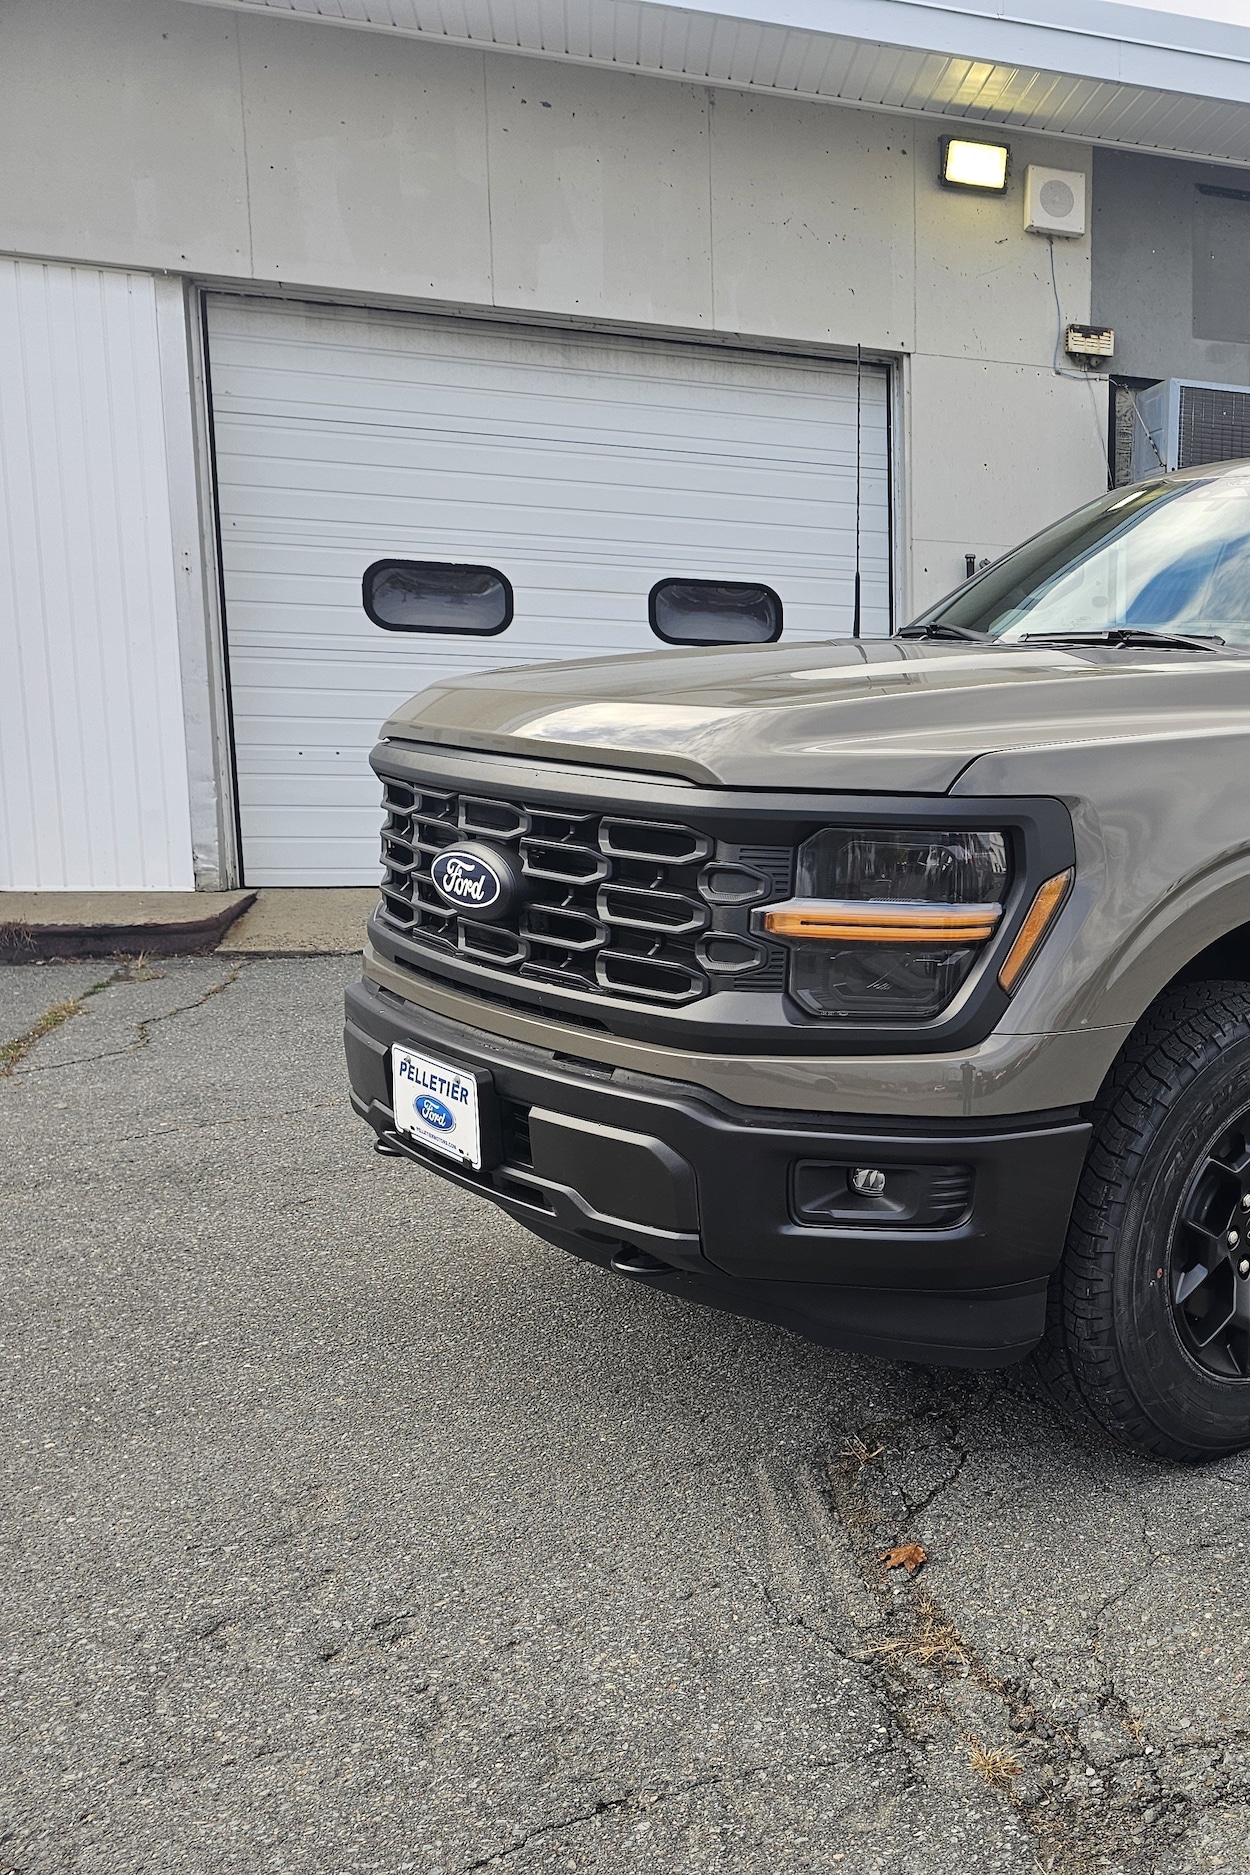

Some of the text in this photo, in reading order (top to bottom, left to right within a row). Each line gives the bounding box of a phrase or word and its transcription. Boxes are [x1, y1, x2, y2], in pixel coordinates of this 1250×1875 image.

[442, 858, 486, 901] Ford
[399, 1061, 469, 1105] PELLETIER
[421, 1099, 447, 1127] Ford
